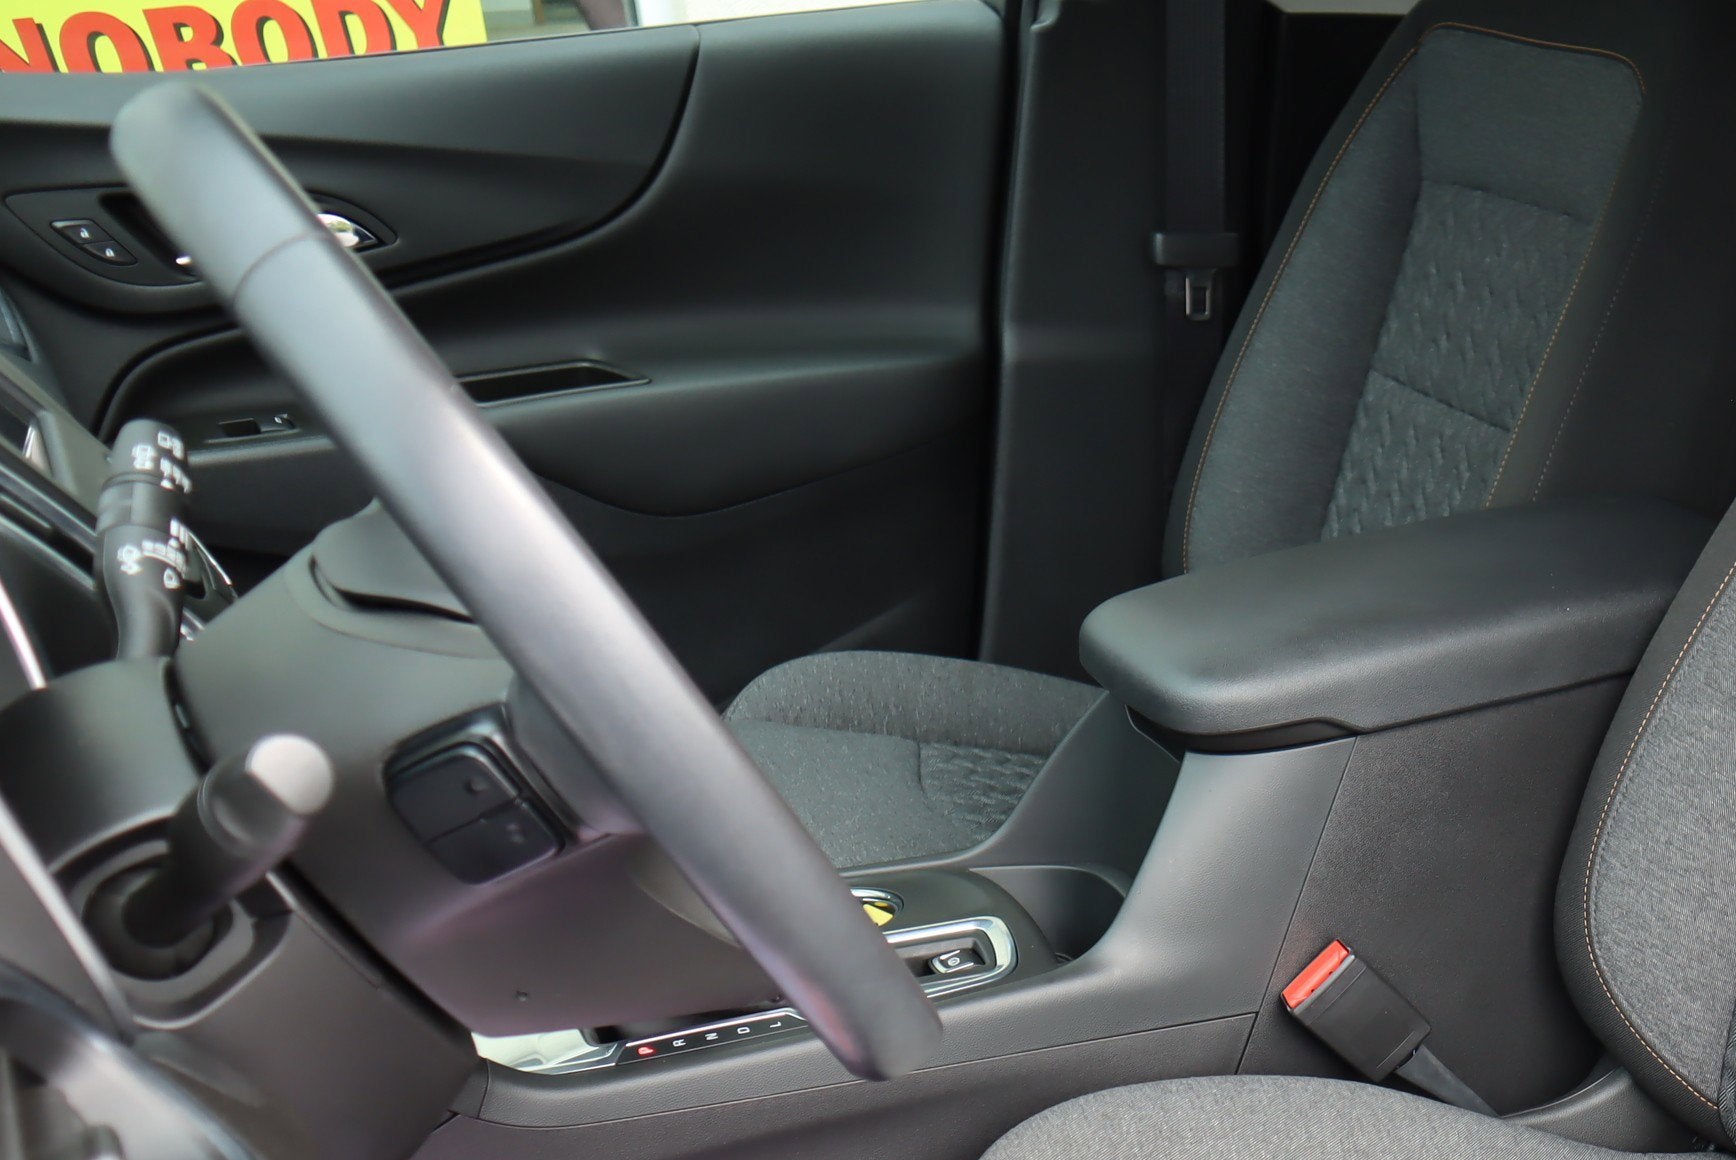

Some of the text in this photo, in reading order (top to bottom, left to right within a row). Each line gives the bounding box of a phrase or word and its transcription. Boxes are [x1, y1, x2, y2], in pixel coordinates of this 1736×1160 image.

[0, 0, 447, 73] NOBODY
[638, 1046, 654, 1055] P
[672, 1038, 686, 1047] R
[705, 1032, 719, 1041] N
[737, 1026, 750, 1035] D
